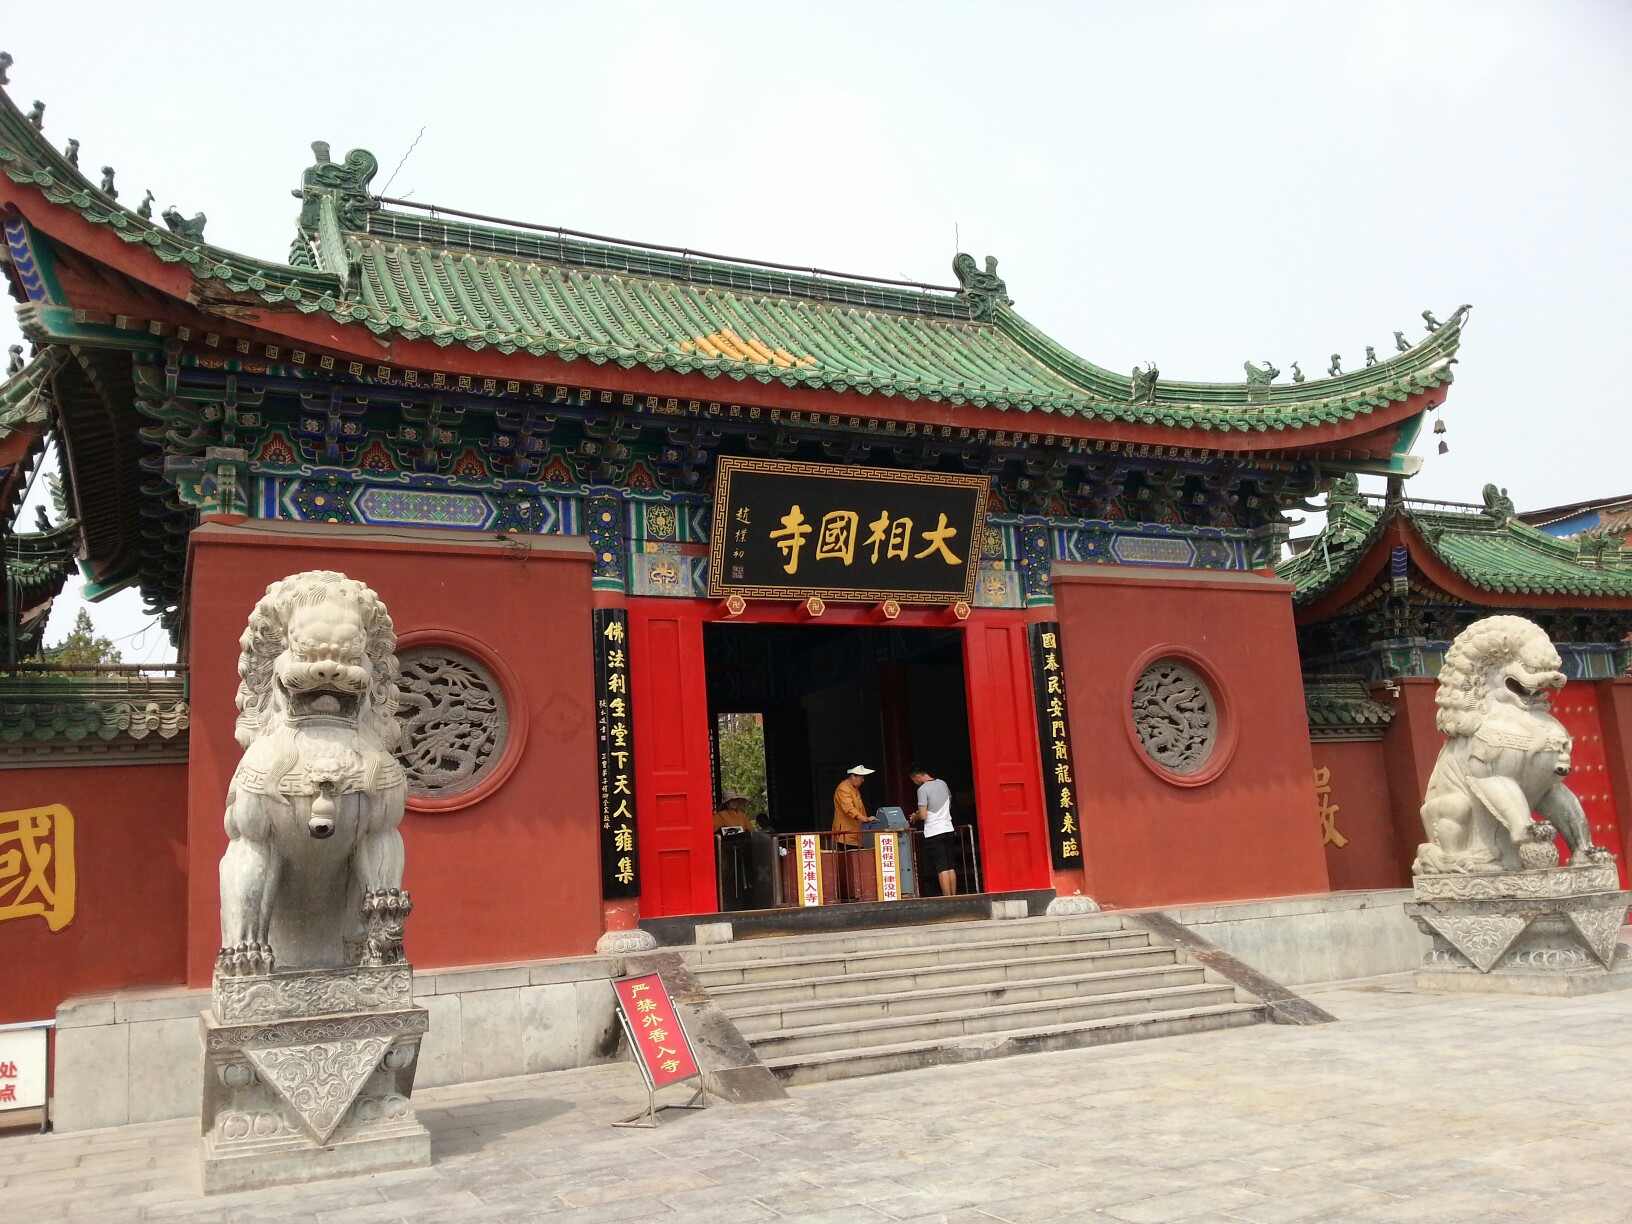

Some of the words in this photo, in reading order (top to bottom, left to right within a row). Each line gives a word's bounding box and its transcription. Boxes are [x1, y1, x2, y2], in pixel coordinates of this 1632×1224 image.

[769, 505, 963, 574] 大相國寺
[802, 838, 818, 903] 外香不准入寺
[881, 838, 897, 898] 使用假证一律没收
[631, 983, 680, 1073] 严禁外香入寺
[0, 1061, 17, 1078] 处
[0, 1084, 16, 1101] 点
